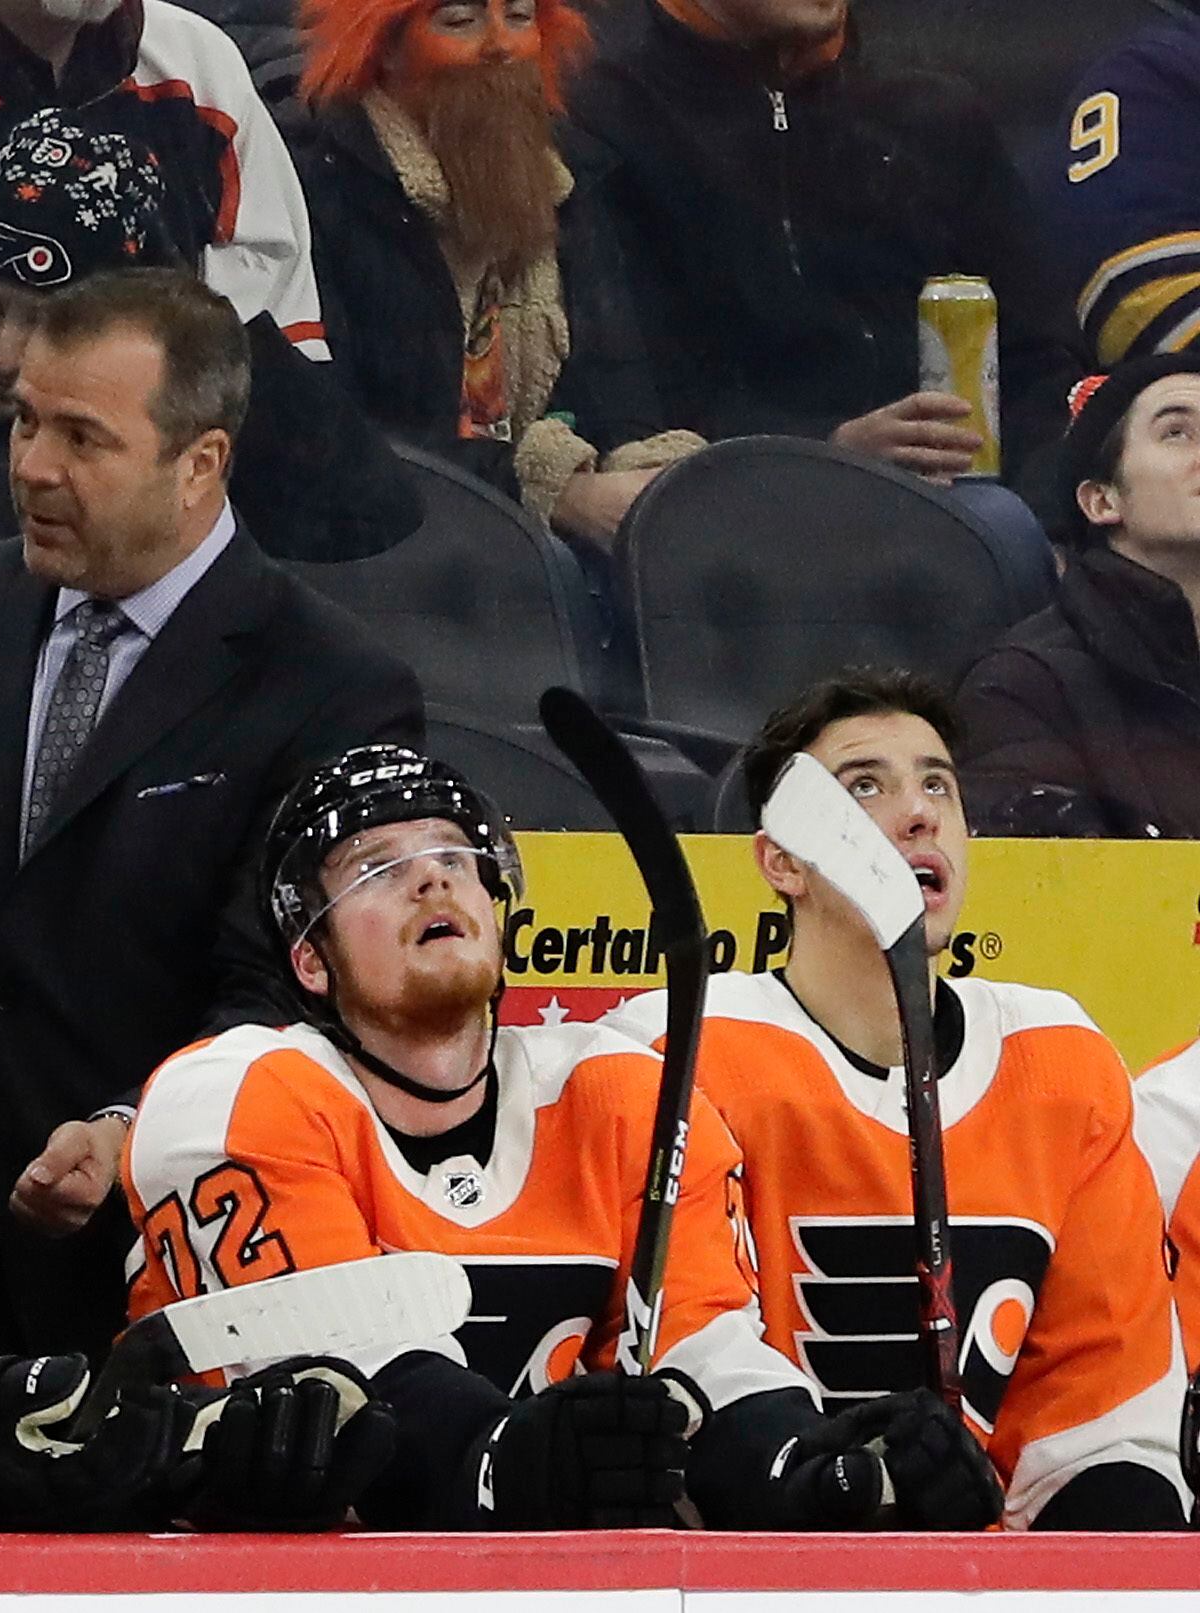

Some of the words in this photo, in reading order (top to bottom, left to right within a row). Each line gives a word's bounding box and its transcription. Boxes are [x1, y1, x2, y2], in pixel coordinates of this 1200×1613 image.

[1068, 91, 1120, 182] 9
[350, 763, 425, 787] CCM
[506, 908, 736, 975] Certao
[665, 1119, 689, 1205] CCM
[142, 1159, 296, 1300] 72
